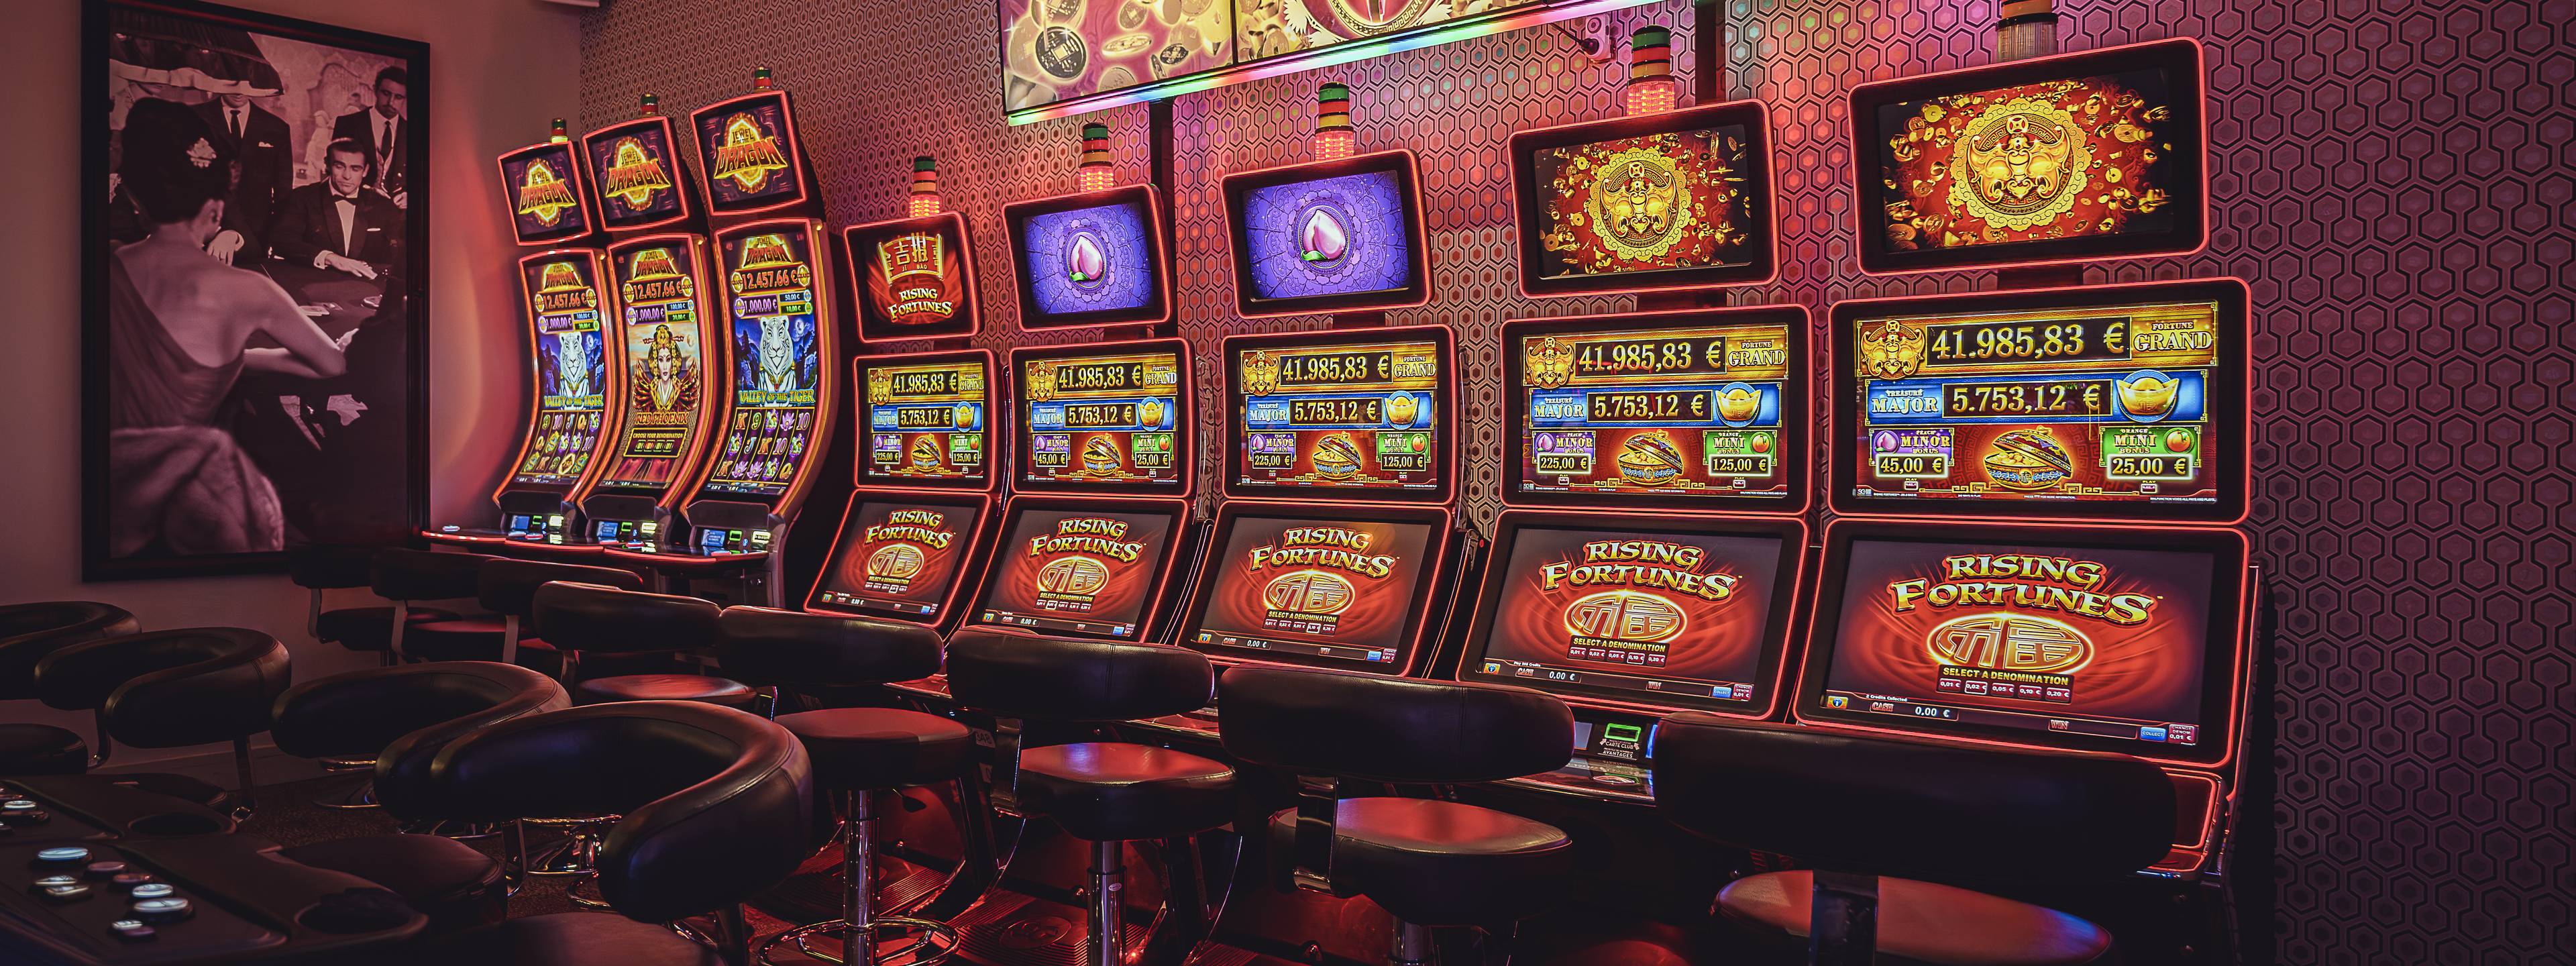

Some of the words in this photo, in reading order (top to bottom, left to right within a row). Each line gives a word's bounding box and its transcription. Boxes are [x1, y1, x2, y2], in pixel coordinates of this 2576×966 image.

[733, 128, 754, 143] JEWEL
[621, 151, 640, 164] JEWEL
[714, 136, 788, 179] DRAGON
[532, 171, 549, 183] JEWEL
[606, 158, 671, 197] DRAGON
[519, 178, 576, 214] DRAGON
[743, 244, 792, 266] DRAGON
[634, 258, 677, 278] DRAGON
[899, 288, 938, 302] RISING
[888, 301, 953, 320] FORTUNES
[2151, 321, 2194, 331] FORTUNE
[1741, 341, 1773, 350] FORTUNE
[1931, 323, 2085, 361] 41.985,83
[2103, 322, 2125, 355] €
[2133, 329, 2213, 353] GRAND
[1578, 342, 1692, 372] 41.985,83
[1706, 341, 1722, 368] €
[1727, 348, 1786, 366] GRAND
[1283, 355, 1367, 382] 41.985,83
[1377, 354, 1389, 379] €
[1393, 362, 1436, 378] GRAND
[893, 373, 945, 394] 41.985,83
[949, 373, 957, 392] €
[959, 380, 984, 390] GRAND
[1059, 366, 1124, 390] 41.985,83
[1132, 365, 1142, 384] €
[1144, 372, 1177, 385] GRAND
[544, 395, 566, 407] VALLEY
[584, 394, 604, 407] TIGER
[739, 390, 767, 403] VALLEY
[777, 392, 787, 401] THE
[789, 389, 815, 405] TIGER
[1886, 388, 1923, 398] TREASURE
[1952, 386, 2067, 414] 5.753,12
[2083, 384, 2102, 411] €
[1295, 401, 1358, 423] 5.753,12
[1366, 400, 1377, 420] €
[1534, 403, 1584, 419] MAJOR
[1595, 394, 1679, 419] 5.753,12
[1690, 394, 1704, 415] €
[1871, 396, 1939, 415] MAJOR
[635, 412, 652, 425] RED
[652, 411, 690, 425] PHOENIX
[751, 412, 762, 430] 9
[796, 412, 810, 430] 10
[873, 415, 896, 426] MAJOR
[900, 409, 939, 426] 5.753,12
[943, 409, 950, 424] €
[1034, 413, 1063, 425] MAJOR
[1069, 405, 1118, 425] 5.753,12
[1124, 405, 1132, 423] €
[1249, 409, 1287, 422] MAJOR
[1046, 439, 1068, 447] MINOR
[1137, 439, 1155, 447] MINI
[1266, 438, 1294, 447] MINOR
[1384, 438, 1407, 447] MINI
[1556, 437, 1593, 448] MINOR
[1713, 437, 1746, 448] MINI
[1900, 436, 1950, 447] MINOR
[2114, 435, 2156, 447] MINI
[877, 452, 893, 462] 225,00
[953, 452, 971, 463] 125,00
[1038, 453, 1057, 465] 45,00
[1061, 453, 1065, 464] €
[1137, 454, 1159, 466] 25,00
[1163, 454, 1168, 465] €
[1254, 455, 1281, 466] 225,00
[1285, 455, 1290, 466] €
[1383, 456, 1412, 469] 125,00
[1417, 456, 1423, 468] €
[1540, 457, 1574, 470] 225,00
[1580, 458, 1587, 469] €
[1713, 458, 1752, 472] 125,00
[1759, 459, 1766, 471] €
[1880, 457, 1923, 474] 45,00
[1932, 458, 1943, 473] €
[2112, 458, 2163, 476] 25,00
[2174, 458, 2186, 474] €
[890, 510, 943, 528] RISING
[1059, 518, 1126, 538] RISING
[865, 525, 953, 549] FORTUNES
[1285, 527, 1373, 552] RISING
[1030, 535, 1143, 562] FORTUNES
[1586, 541, 1703, 570] RISING
[1251, 546, 1396, 578] FORTUNES
[1945, 555, 2102, 591] RISING
[1542, 561, 1737, 602] FORTUNES
[1061, 594, 1093, 602] DENOMINATION
[1893, 579, 2155, 625] FORTUNES
[1268, 610, 1288, 619] SELECT
[1294, 613, 1337, 623] DENOMINATION
[1573, 637, 1601, 647] SELECT
[1608, 641, 1666, 652] DENOMINATION
[1943, 667, 1980, 678] SELECT
[1981, 671, 1988, 679] A
[1990, 671, 2070, 686] DENOMINATION
[1872, 702, 1894, 712] CASH
[1915, 706, 1937, 716] 0.00
[1943, 709, 1950, 717] €
[2050, 719, 2069, 730] WIN
[1603, 750, 1633, 758] AVANTAGES
